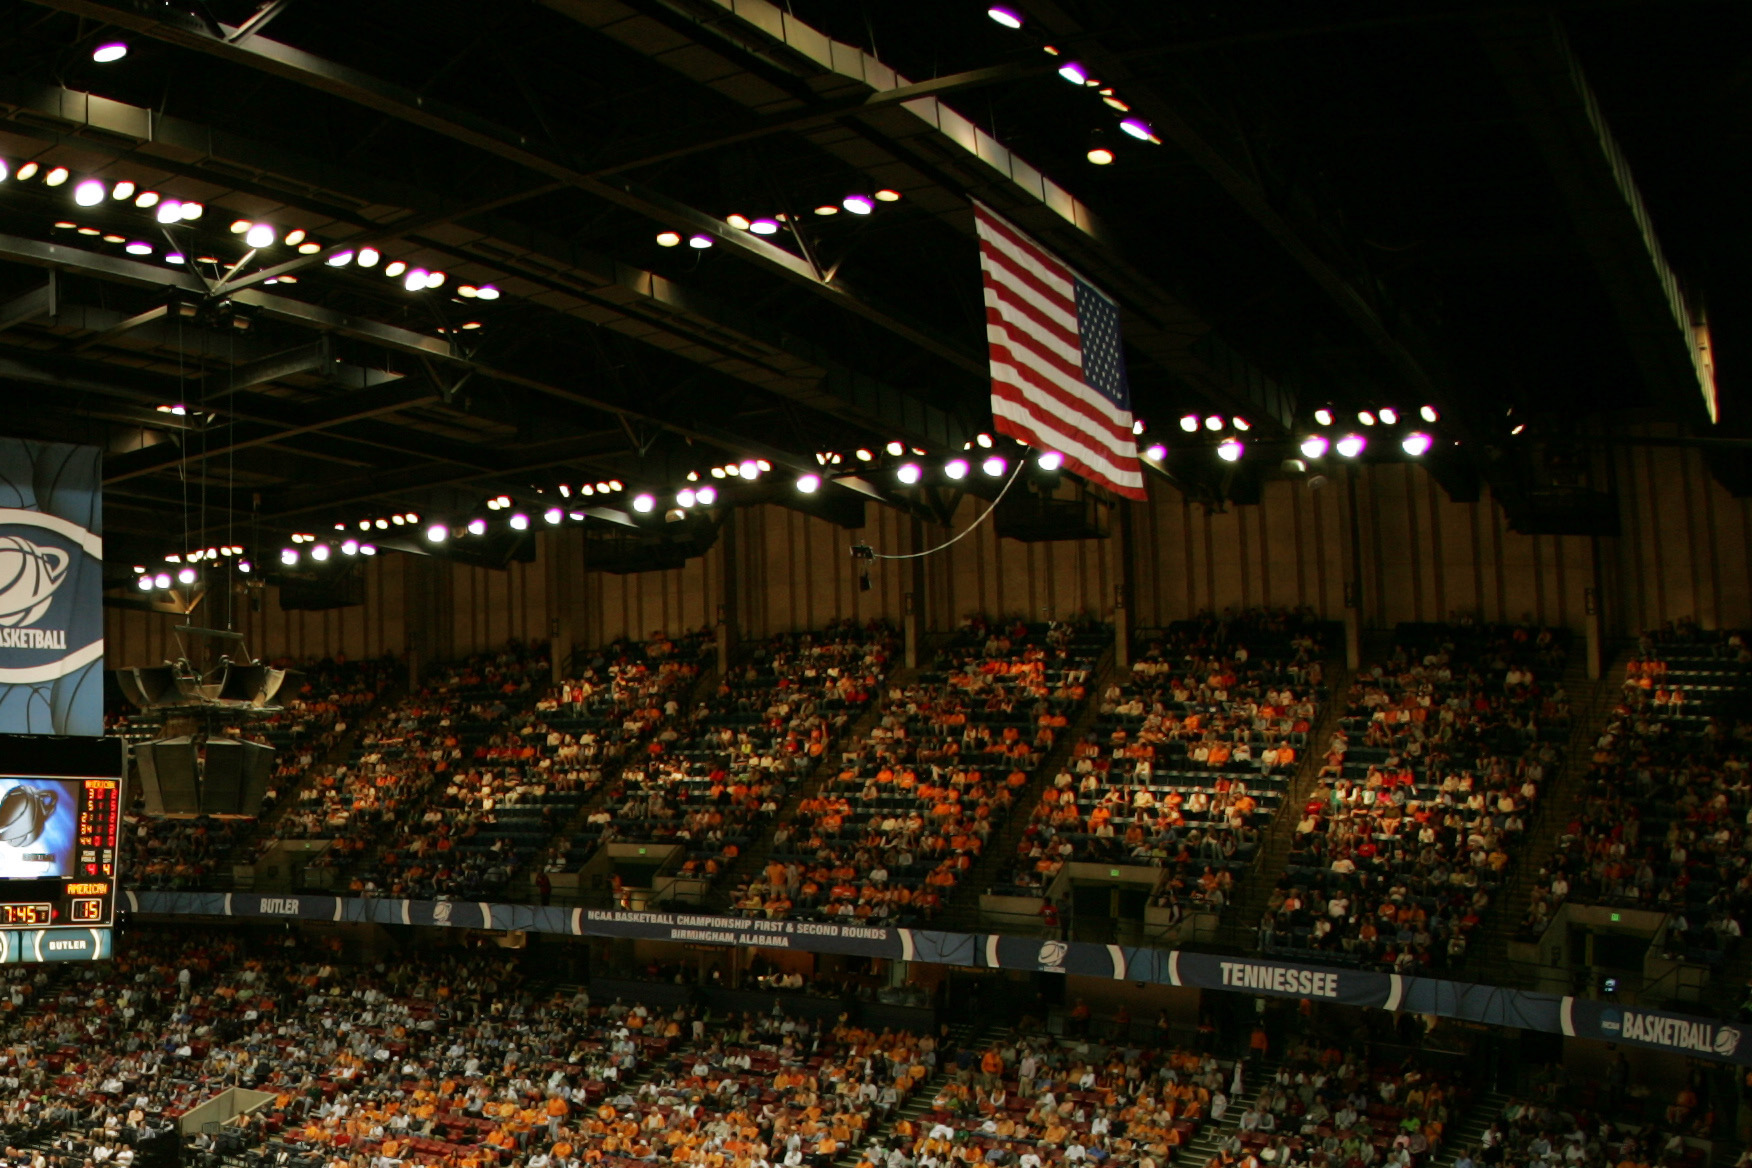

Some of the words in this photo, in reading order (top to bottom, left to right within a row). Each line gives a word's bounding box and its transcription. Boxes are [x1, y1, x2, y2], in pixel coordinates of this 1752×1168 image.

[66, 883, 108, 895] AMERICAN
[4, 905, 37, 923] 7:45
[84, 901, 99, 919] 15
[259, 897, 299, 915] BUTLER
[588, 911, 612, 921] NCAA
[615, 912, 674, 925] BASKETBALL
[677, 915, 752, 930] CHAMPIONSHIP
[754, 921, 784, 932] FIRST
[786, 923, 794, 933] &
[797, 923, 838, 936] SECOND
[842, 927, 887, 940] ROUNDS
[49, 940, 86, 950] BUTLER
[671, 928, 737, 944] BIRMINGHAM,
[739, 933, 789, 947] ALABAMA
[1220, 962, 1338, 998] TENNESSEE
[1622, 1011, 1714, 1053] BASKETBALL
